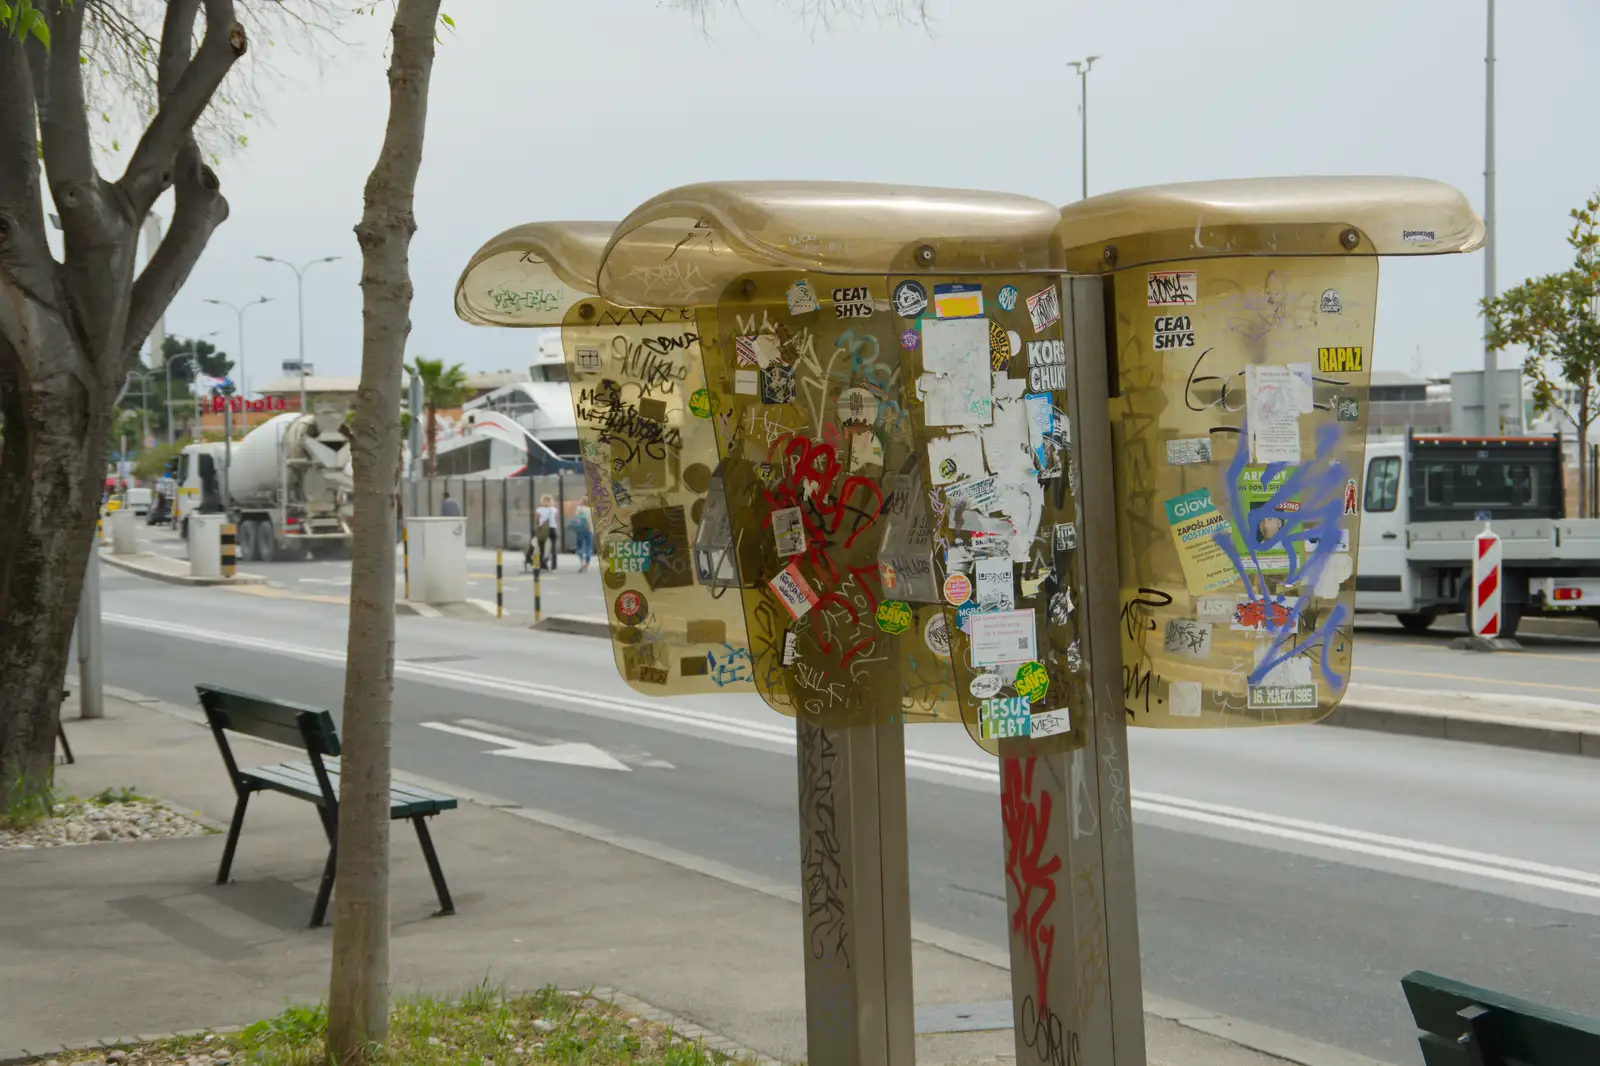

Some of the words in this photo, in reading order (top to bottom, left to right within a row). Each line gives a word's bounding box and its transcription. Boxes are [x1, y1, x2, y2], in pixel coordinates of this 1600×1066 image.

[1154, 332, 1195, 349] SHYS
[1319, 348, 1362, 371] RAPAZ
[609, 541, 650, 558] JESUS
[614, 558, 645, 573] LEBT
[981, 696, 1031, 720] JESUS
[989, 717, 1026, 739] LEBT
